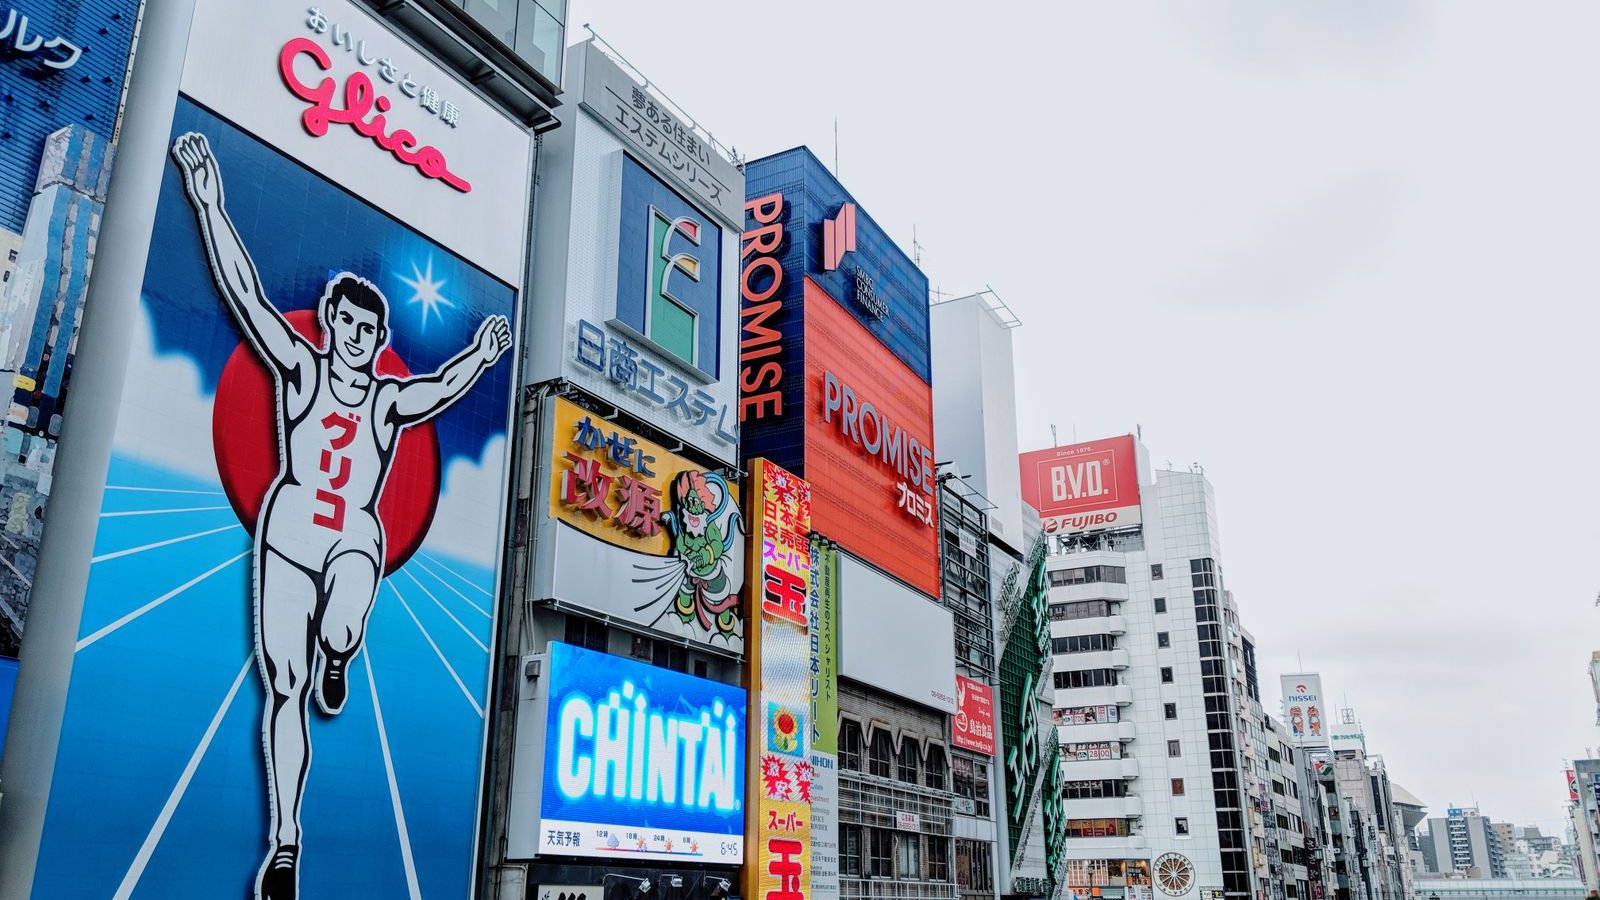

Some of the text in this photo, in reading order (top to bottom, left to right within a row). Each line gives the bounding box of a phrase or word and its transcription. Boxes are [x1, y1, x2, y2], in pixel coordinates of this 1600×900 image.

[306, 7, 460, 128] おいしさと健康
[615, 104, 722, 206] エステムシリーズ
[631, 85, 710, 165] 夢ある住まい
[740, 193, 783, 422] PROMISE
[856, 289, 884, 323] FINANCE
[313, 411, 362, 532] グリコ
[572, 416, 656, 479] かぜに
[824, 369, 933, 496] PROMISE
[561, 451, 662, 538] 改源
[896, 481, 934, 528] プロミス
[1051, 460, 1109, 502] B.V.D.
[1061, 511, 1118, 530] FUJIBO
[763, 540, 810, 572] スーパー
[810, 546, 820, 744] 株式会社日本リート
[559, 681, 735, 810] CHINTAI
[547, 830, 581, 847] 天気予報
[768, 810, 804, 832] スーパー
